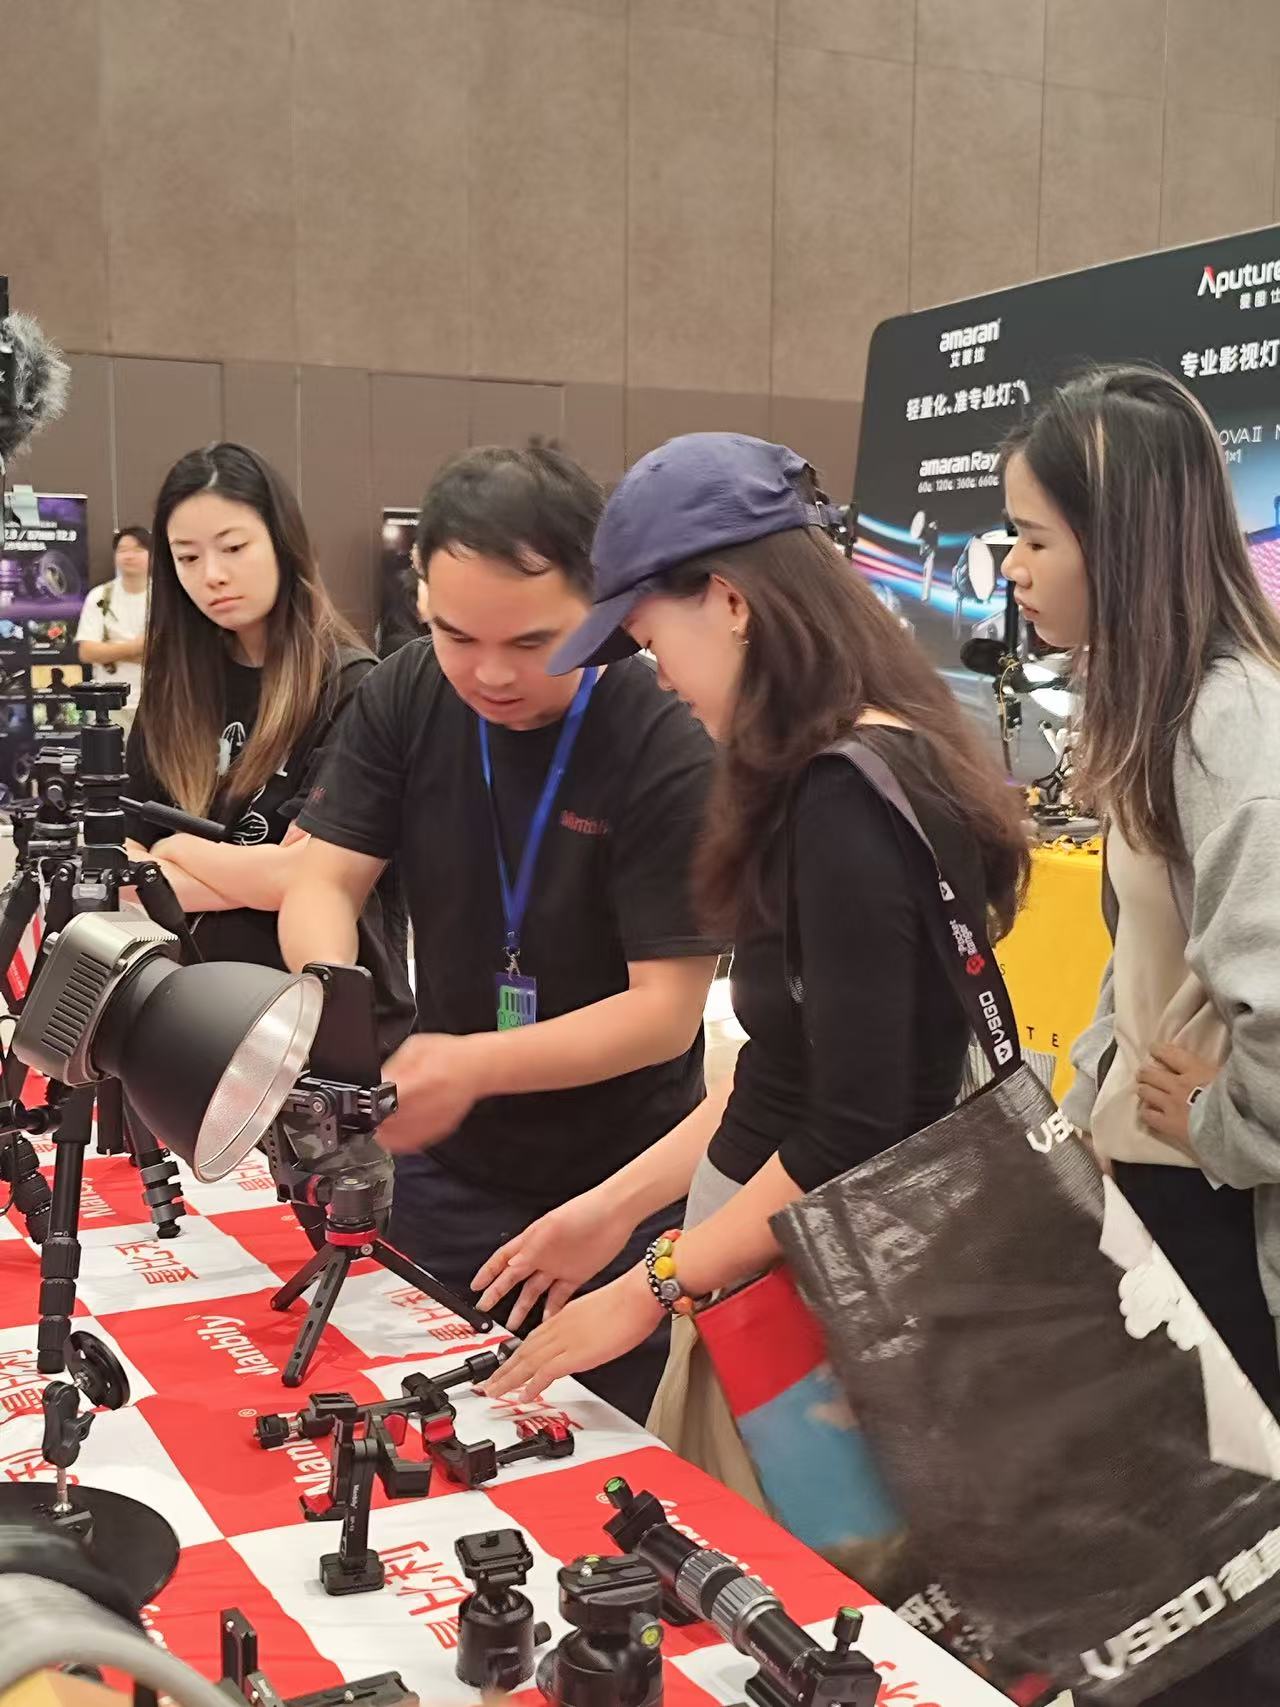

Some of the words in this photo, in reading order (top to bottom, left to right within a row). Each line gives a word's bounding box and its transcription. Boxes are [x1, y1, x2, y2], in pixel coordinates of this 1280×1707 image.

[939, 320, 1000, 353] amaran
[1180, 339, 1280, 378] 专业影视灯
[905, 380, 1031, 421] 轻量化、准专业灯
[979, 990, 1006, 1045] VSGO
[197, 1315, 280, 1376] Manbily
